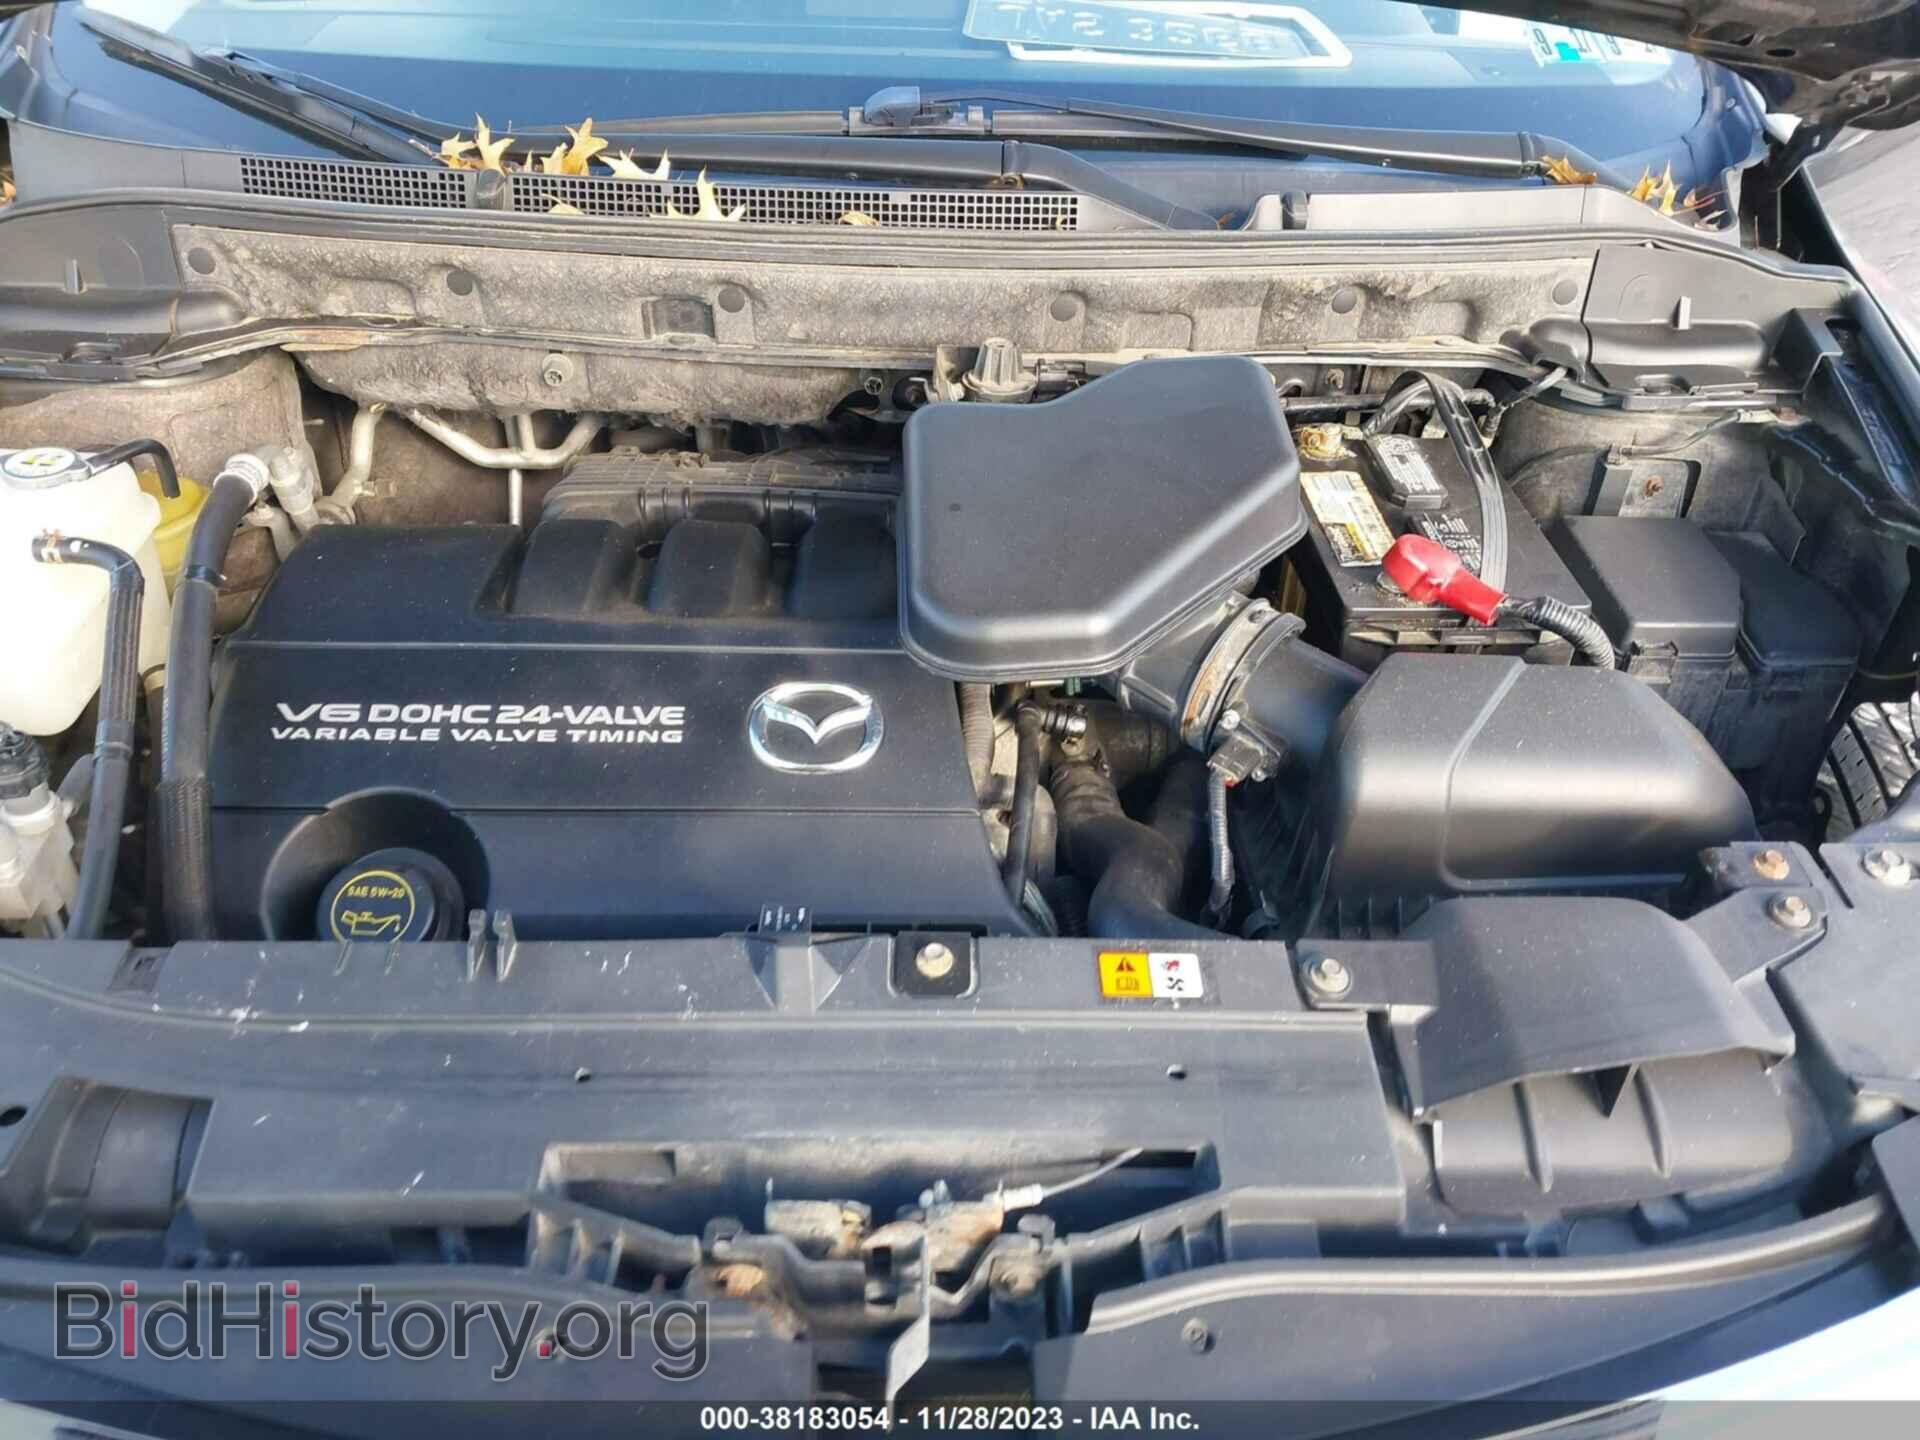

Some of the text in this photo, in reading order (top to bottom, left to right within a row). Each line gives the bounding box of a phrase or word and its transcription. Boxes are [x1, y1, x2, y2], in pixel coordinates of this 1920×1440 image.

[276, 703, 686, 726] V6 DOHC 24-VALVE
[270, 727, 684, 743] VARIABLE VALVE TIMING
[347, 885, 368, 897] SAE
